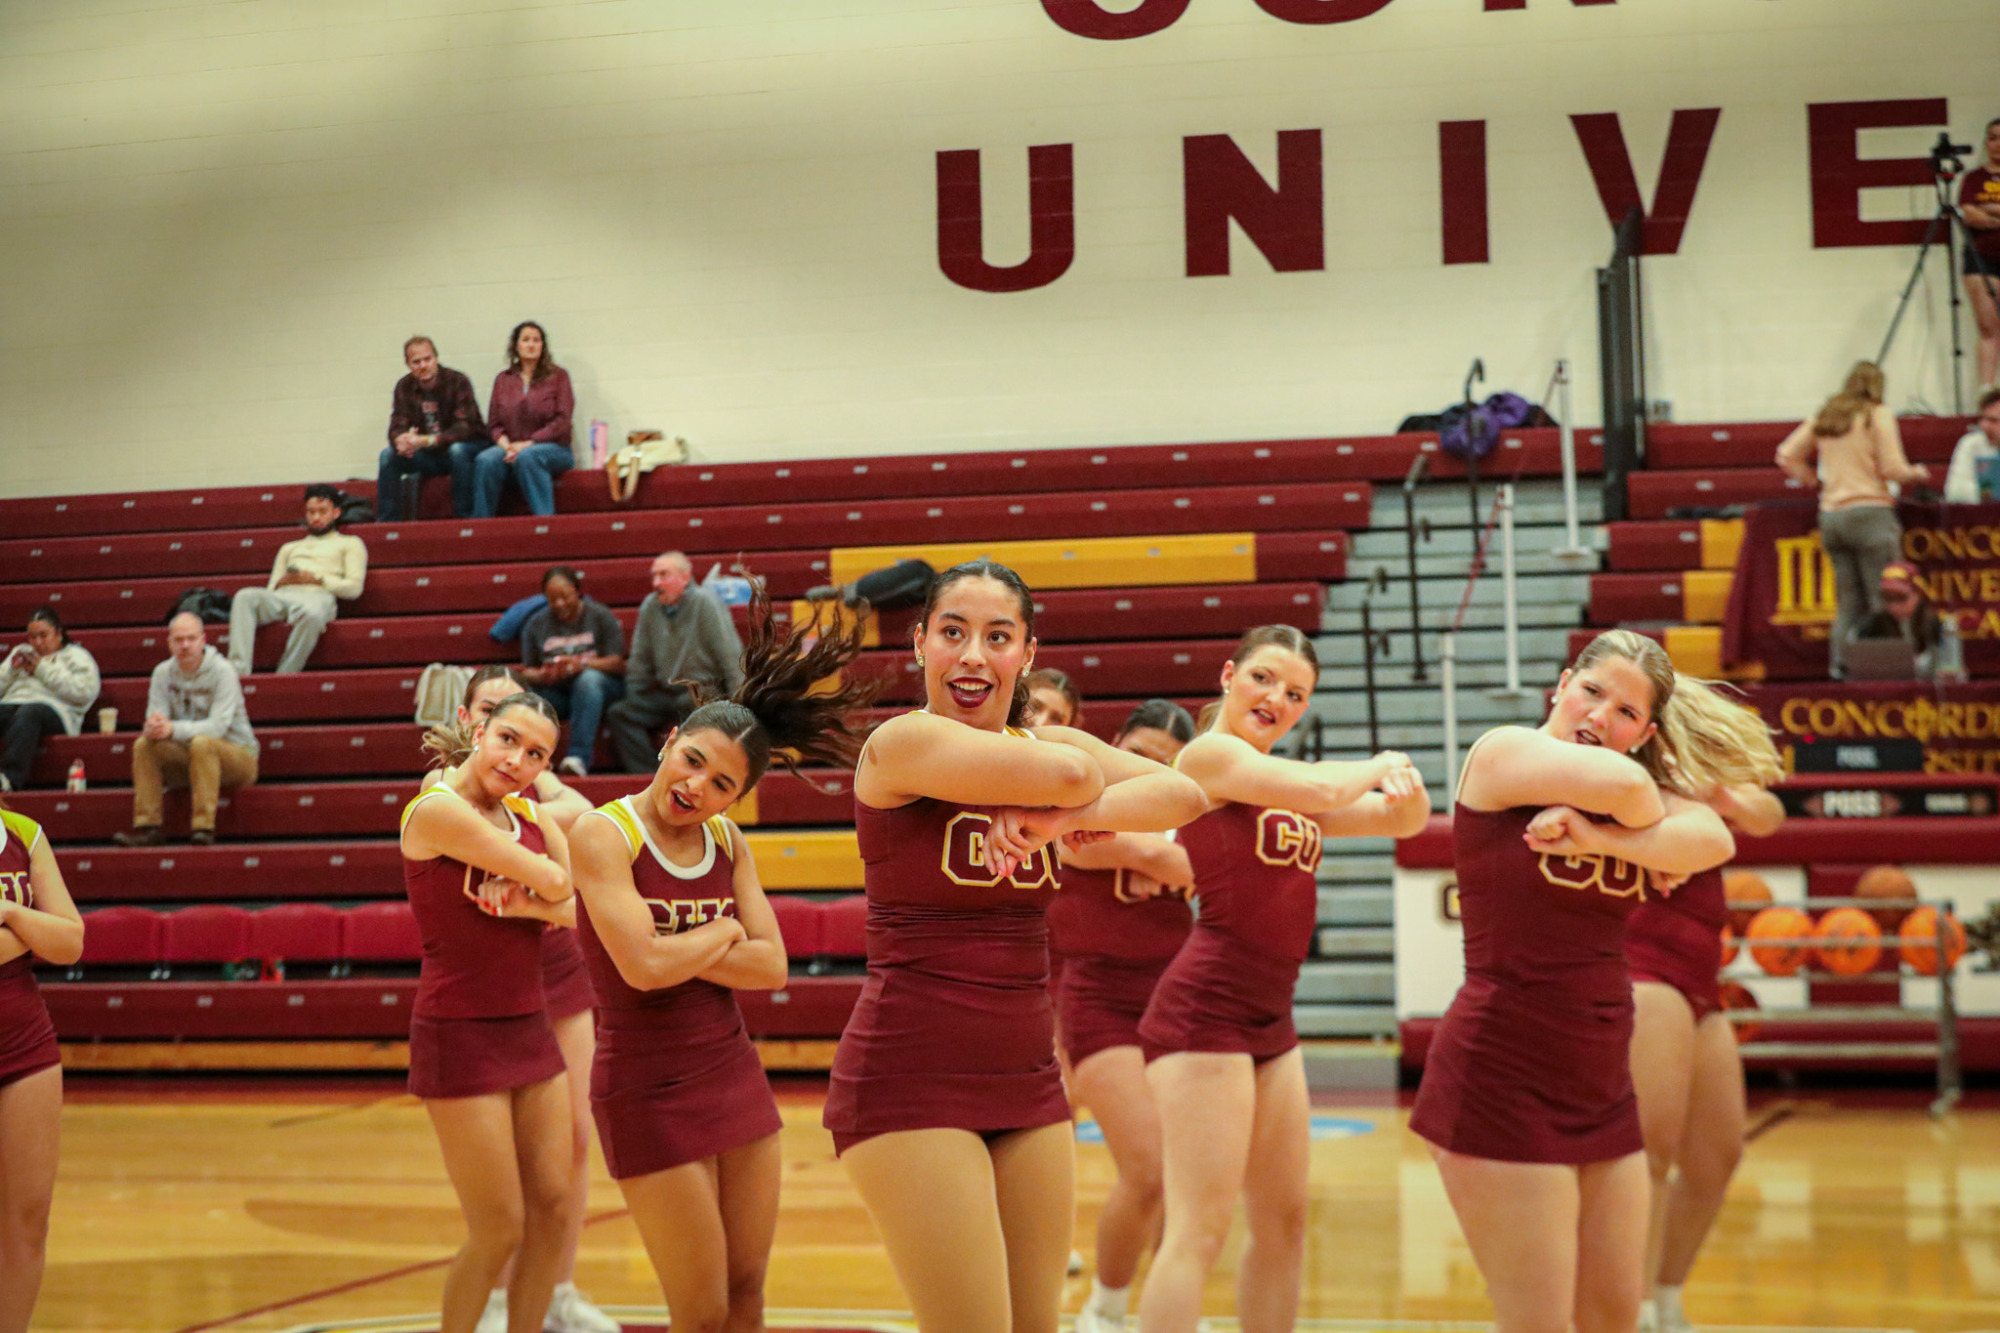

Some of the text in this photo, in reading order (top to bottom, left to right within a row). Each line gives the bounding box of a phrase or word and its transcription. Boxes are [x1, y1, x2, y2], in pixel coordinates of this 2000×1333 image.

[935, 98, 1949, 293] UNIVE
[1904, 525, 2000, 560] ONC
[1912, 569, 2000, 602] NIVE
